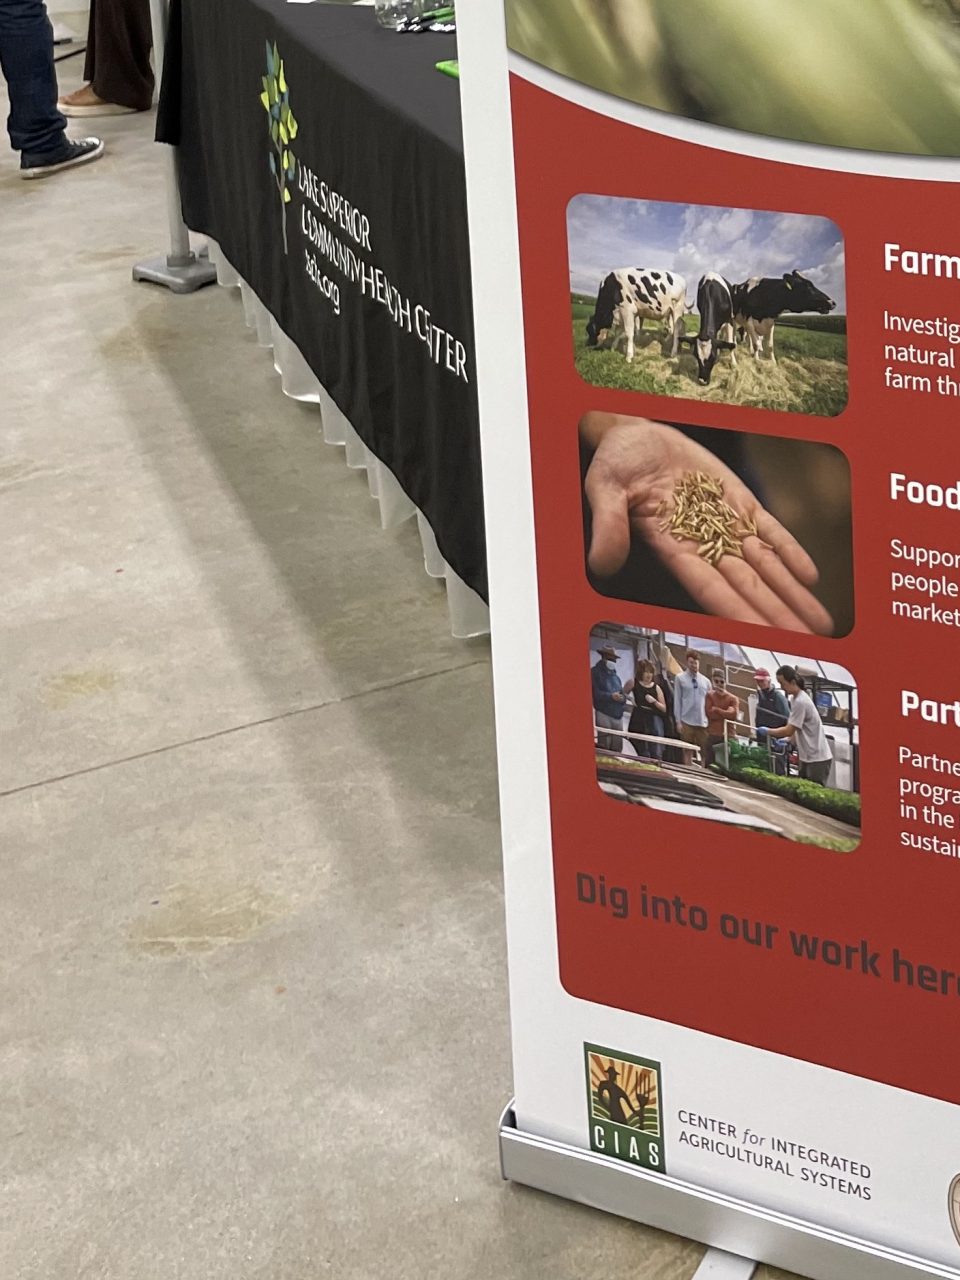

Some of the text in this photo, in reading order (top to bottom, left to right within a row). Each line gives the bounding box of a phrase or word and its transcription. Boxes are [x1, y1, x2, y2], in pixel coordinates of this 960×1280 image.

[298, 159, 372, 251] LAKE SUPERIOR
[884, 344, 954, 368] natural
[885, 367, 931, 392] farm
[891, 571, 959, 597] people
[900, 799, 917, 819] in
[923, 805, 954, 828] the
[577, 872, 628, 918] Dig
[641, 885, 707, 931] into
[720, 914, 778, 949] our
[789, 929, 880, 977] work
[594, 1124, 659, 1166] CIAS
[678, 1110, 871, 1179] CENTER for INTEGRATED
[679, 1131, 871, 1200] AGRICULTURAL SYSTEMS
